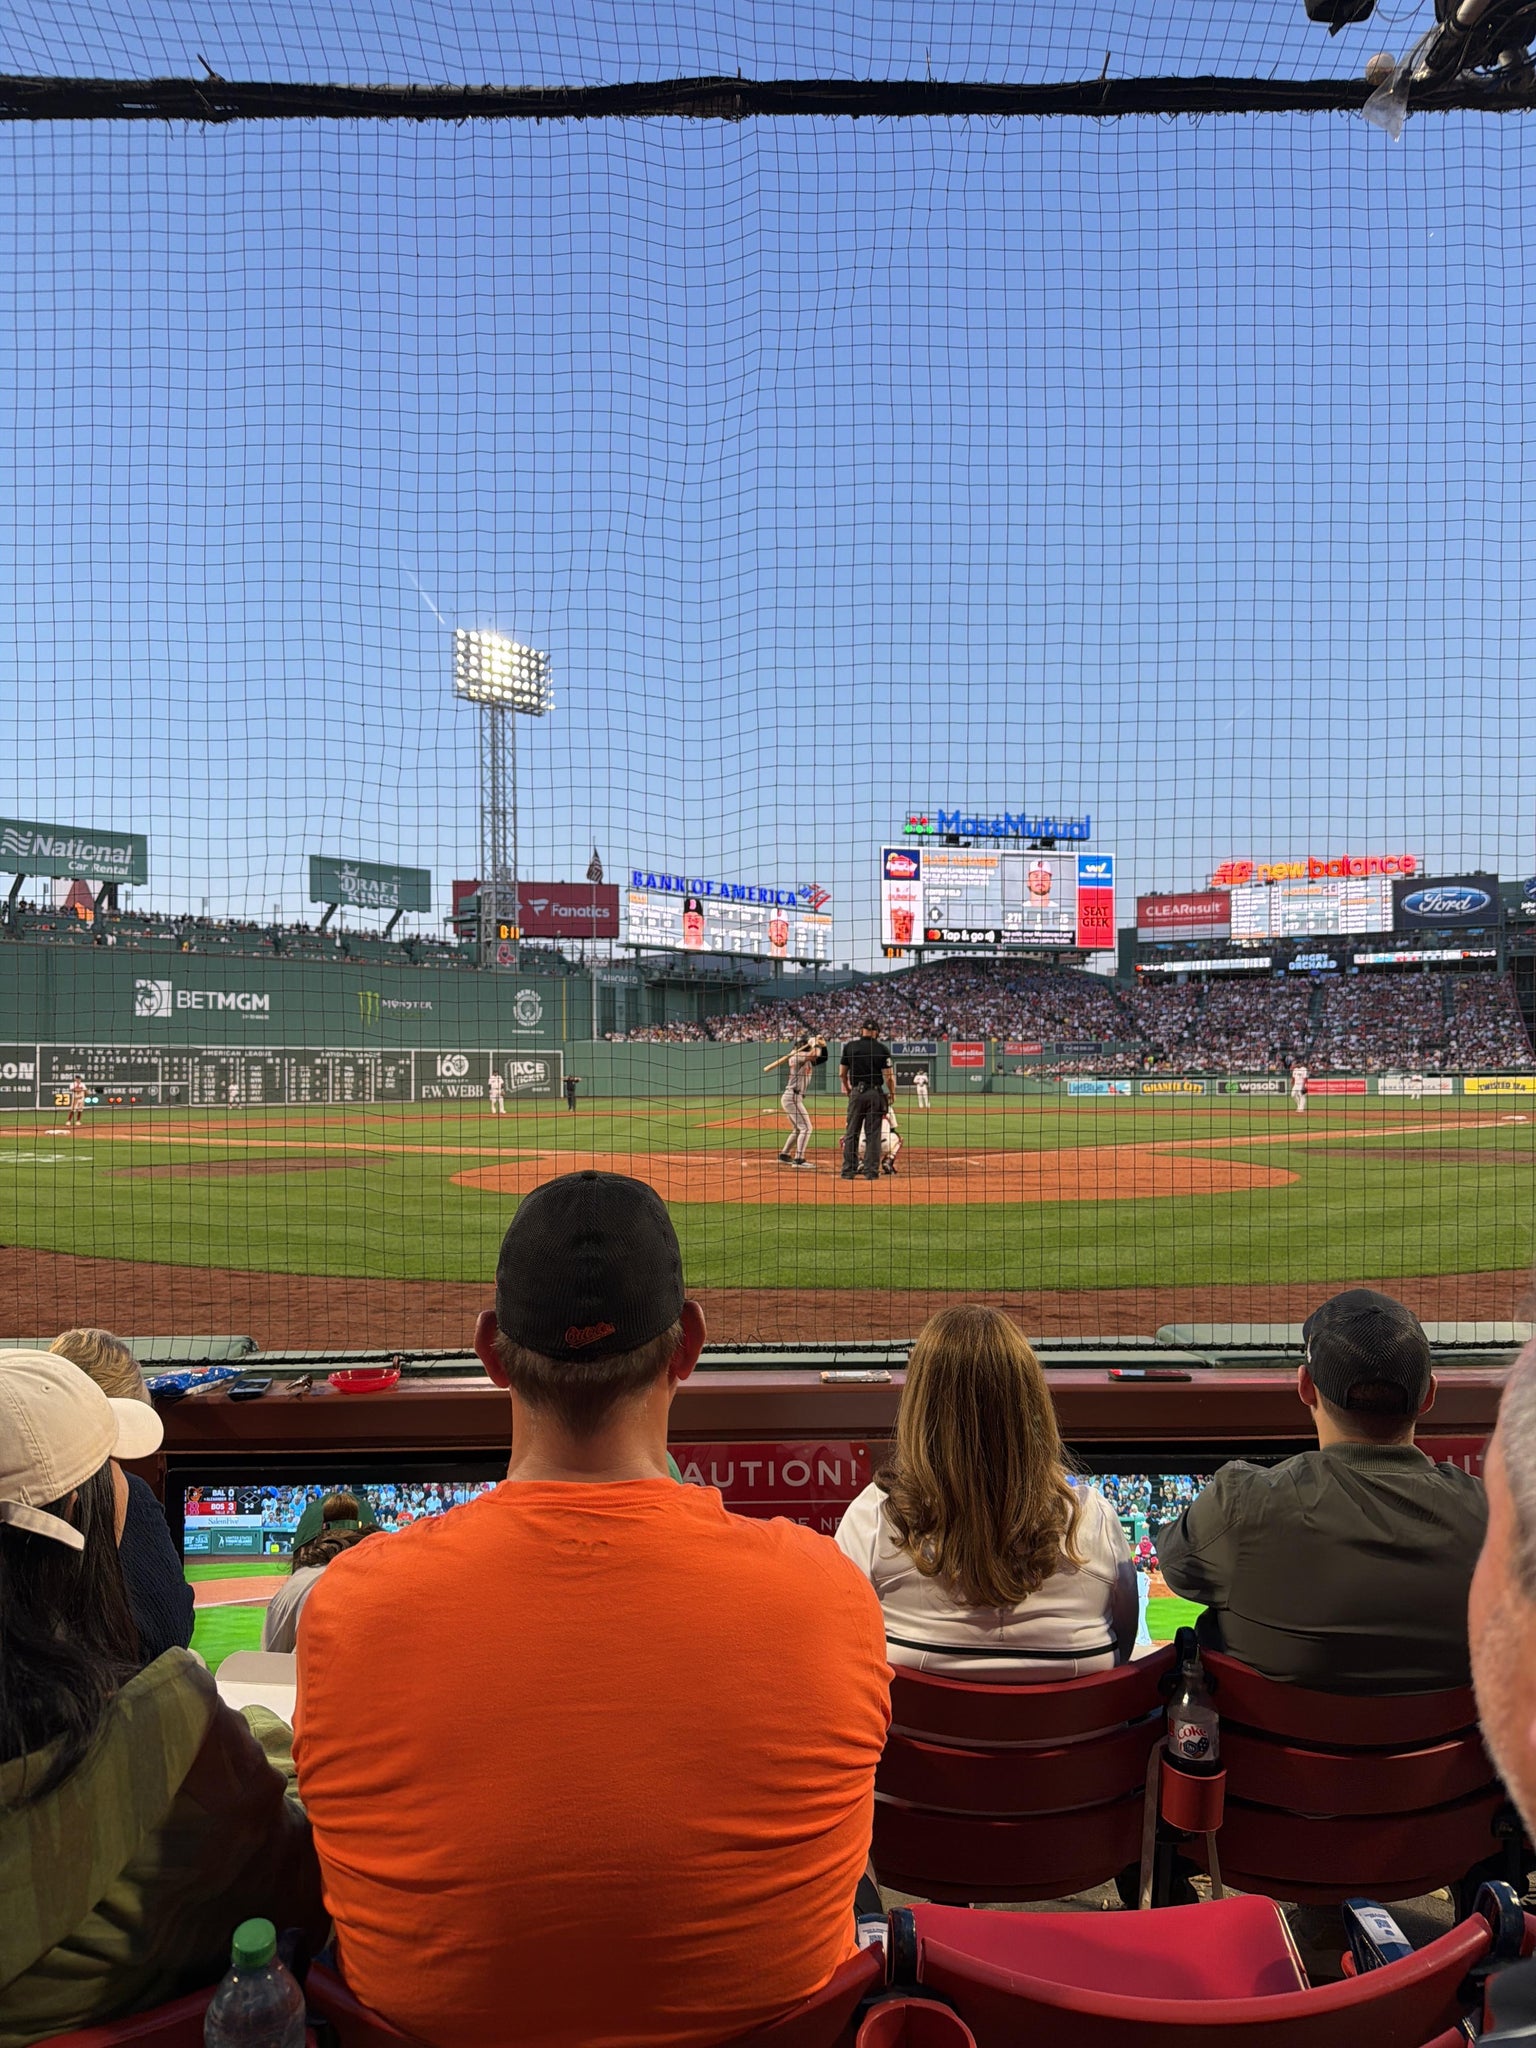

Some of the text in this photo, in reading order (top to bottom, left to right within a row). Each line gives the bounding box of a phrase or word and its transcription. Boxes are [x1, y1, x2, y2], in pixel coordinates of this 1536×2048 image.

[937, 808, 1091, 839] MassMutual
[32, 834, 132, 864] National
[68, 861, 129, 875] Car Rental
[1257, 862, 1306, 883] new
[1308, 853, 1418, 879] balance
[339, 876, 400, 895] DRAFT
[633, 870, 797, 906] BANK OF AMERICA
[347, 890, 399, 907] KINGS
[1419, 893, 1473, 912] Ford
[552, 903, 610, 918] Fanatics
[1084, 906, 1109, 917] SEAT
[1146, 902, 1221, 917] CLEAResult
[1082, 918, 1109, 928] GEEK
[941, 929, 960, 941] Tap
[971, 932, 984, 943] go
[1289, 961, 1337, 970] ORCHARD
[1295, 954, 1328, 963] ANGRY
[177, 990, 269, 1010] BETMGM
[382, 1000, 432, 1009] MONSTER
[0, 1062, 35, 1080] ON
[437, 1055, 469, 1077] 160
[514, 1062, 545, 1075] ACE
[515, 1073, 545, 1085] TICKET
[1240, 1081, 1278, 1090] wasabi
[422, 1085, 484, 1098] F.W. WEBB
[1143, 1081, 1203, 1093] GRANITE CITY
[55, 1094, 70, 1105] 23
[682, 1460, 857, 1487] AUTION!
[228, 1489, 234, 1497] 0
[1178, 1726, 1207, 1740] Coke
